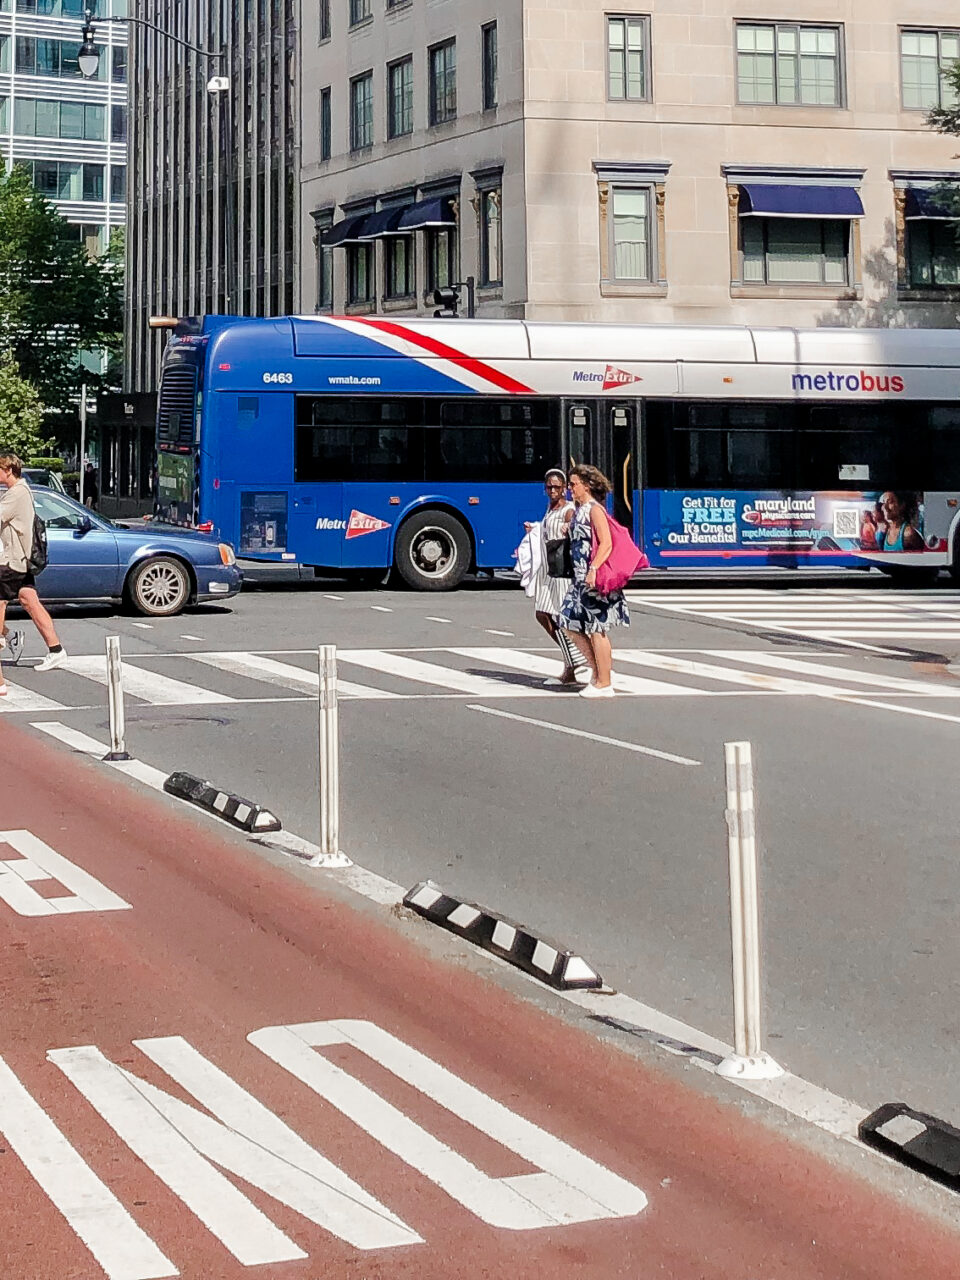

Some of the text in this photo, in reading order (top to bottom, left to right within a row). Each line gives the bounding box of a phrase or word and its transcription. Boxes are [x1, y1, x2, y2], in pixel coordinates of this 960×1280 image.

[263, 373, 293, 384] 6463
[328, 376, 381, 385] wmata.com
[573, 371, 604, 382] Metro
[791, 370, 905, 392] metrobus
[683, 497, 736, 508] Get Fit for
[754, 497, 815, 513] maryland
[682, 508, 736, 522] FREE
[351, 518, 382, 529] Extra
[684, 523, 737, 533] It's One of
[668, 532, 737, 543] Our Benefits!
